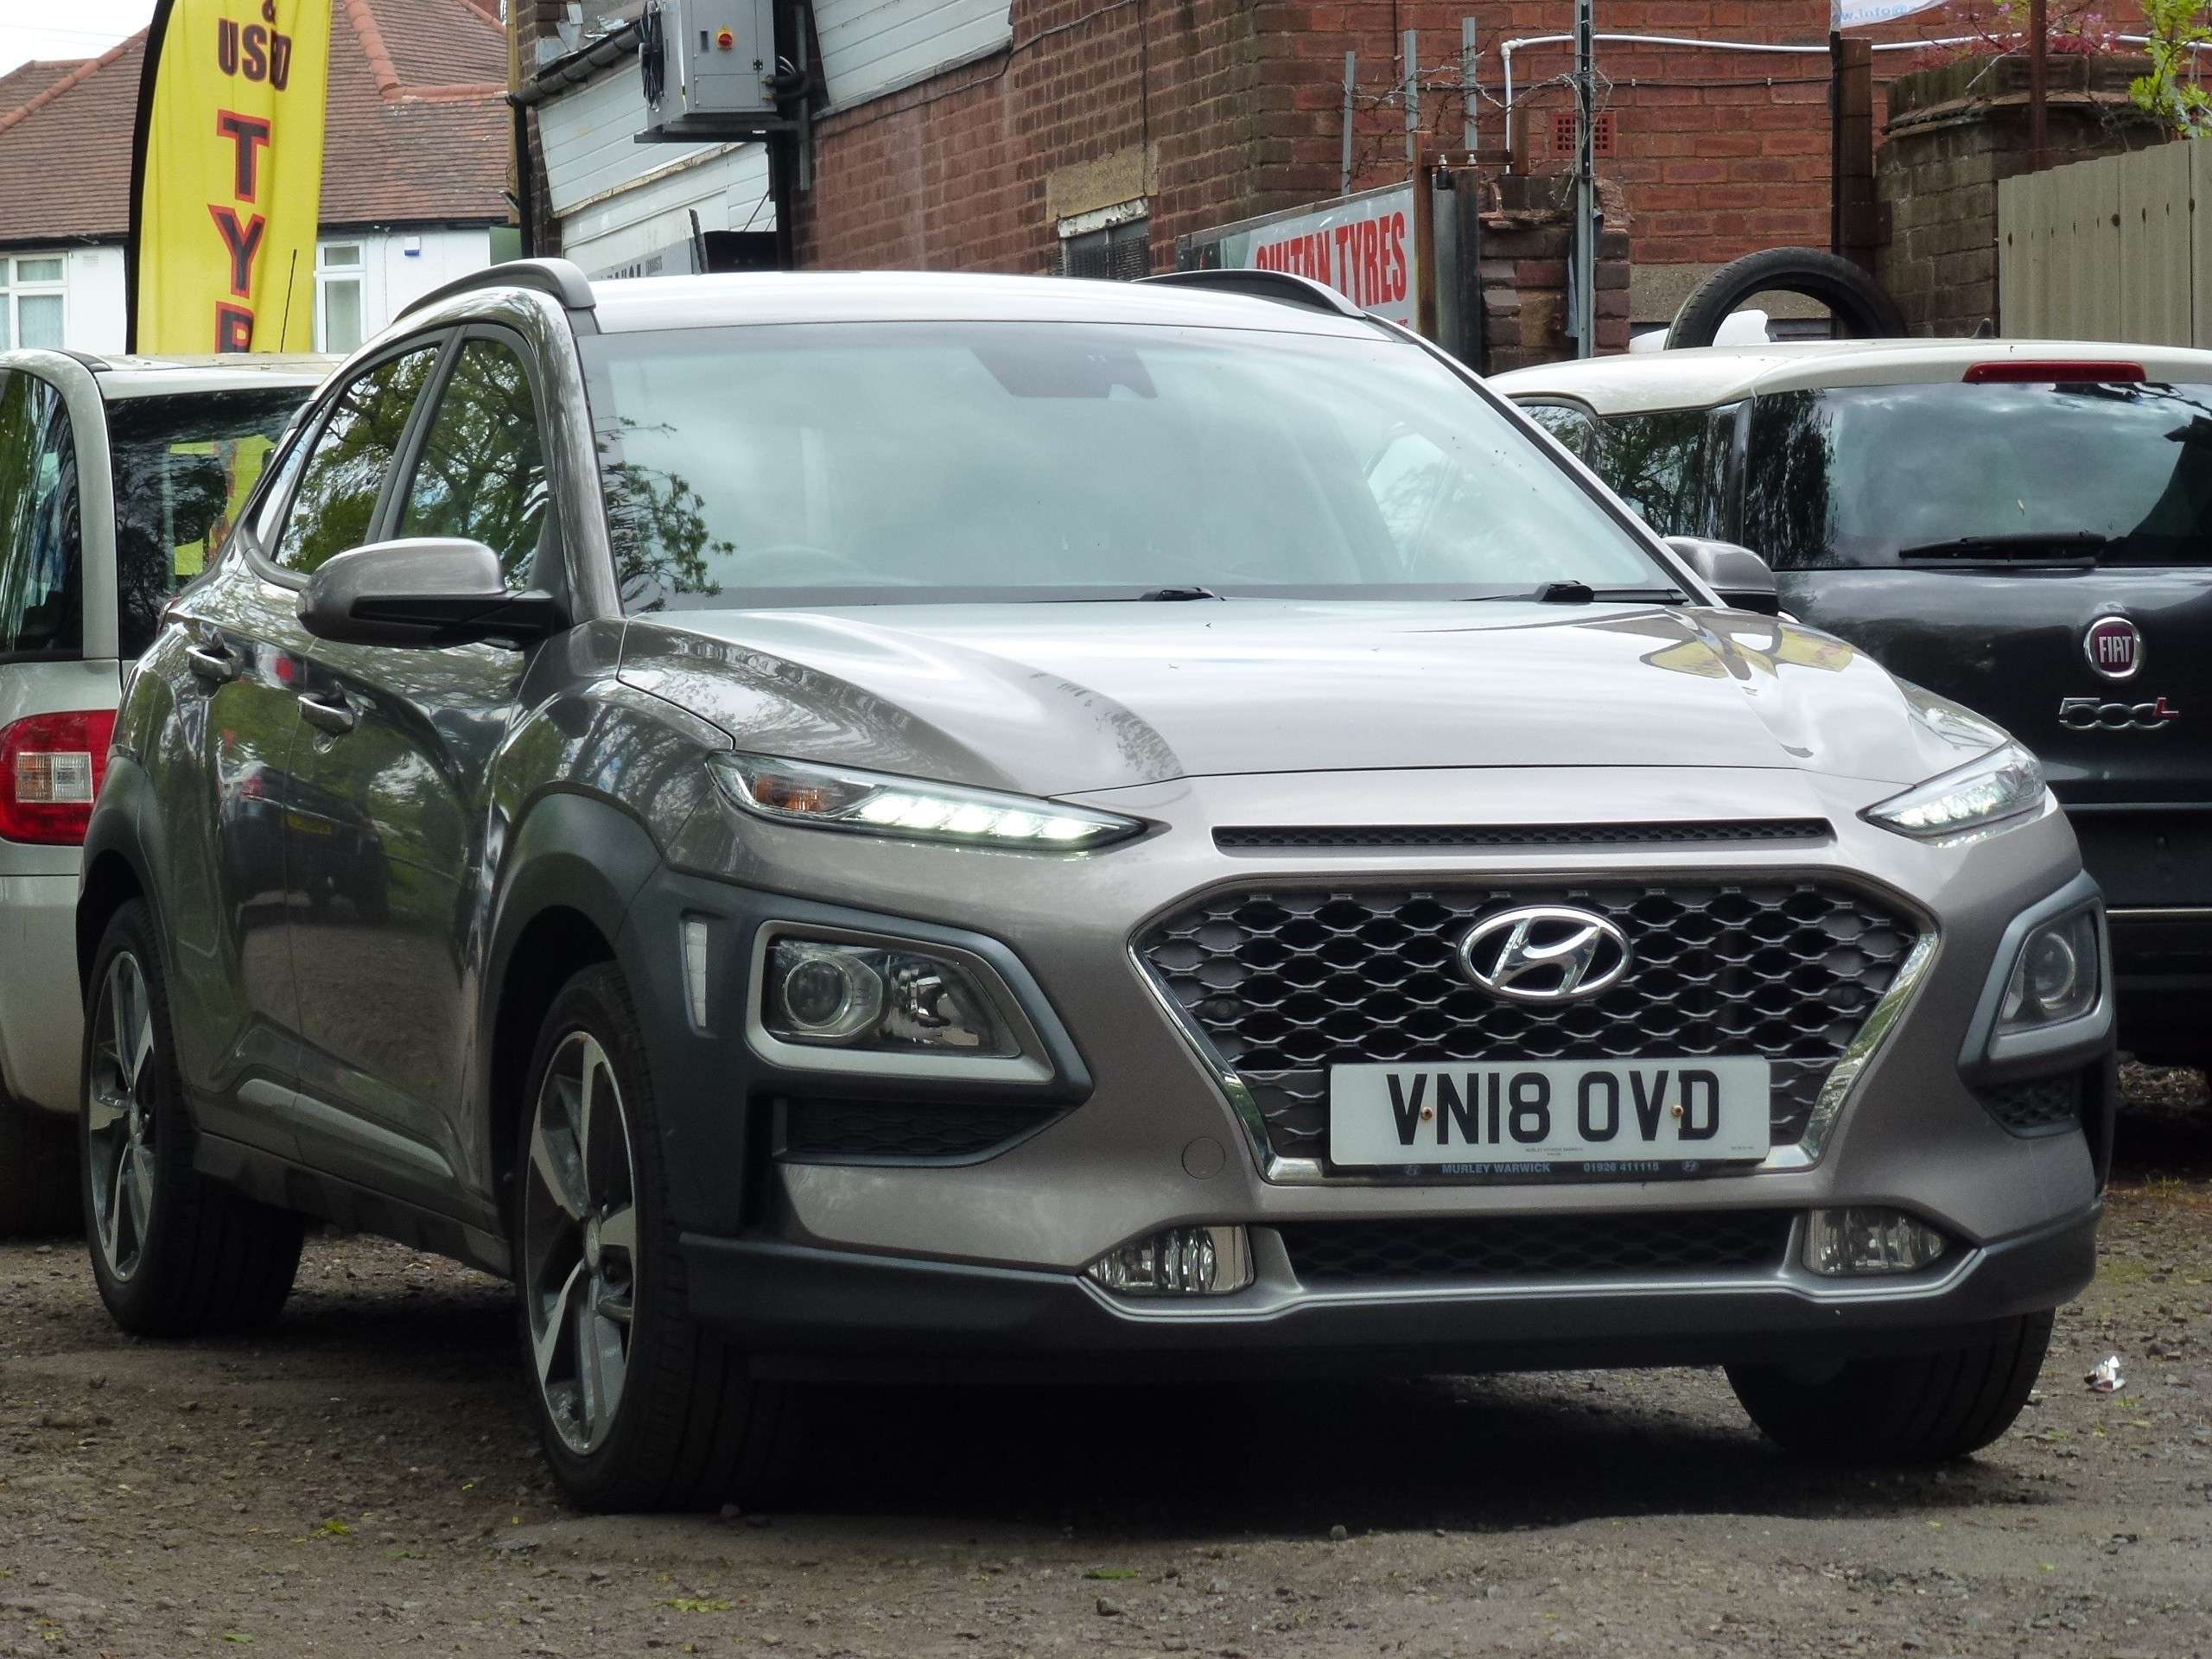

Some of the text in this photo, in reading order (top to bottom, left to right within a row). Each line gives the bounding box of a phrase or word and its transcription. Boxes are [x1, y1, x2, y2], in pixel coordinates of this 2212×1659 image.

[219, 17, 292, 92] USD
[1336, 212, 1407, 308] TYRES
[2098, 636, 2132, 664] FIAT
[2059, 697, 2179, 730] 500L
[1386, 1069, 1720, 1146] VN18 OVD
[1441, 1163, 1491, 1174] MURLEY
[1493, 1161, 1550, 1173] WARWICK
